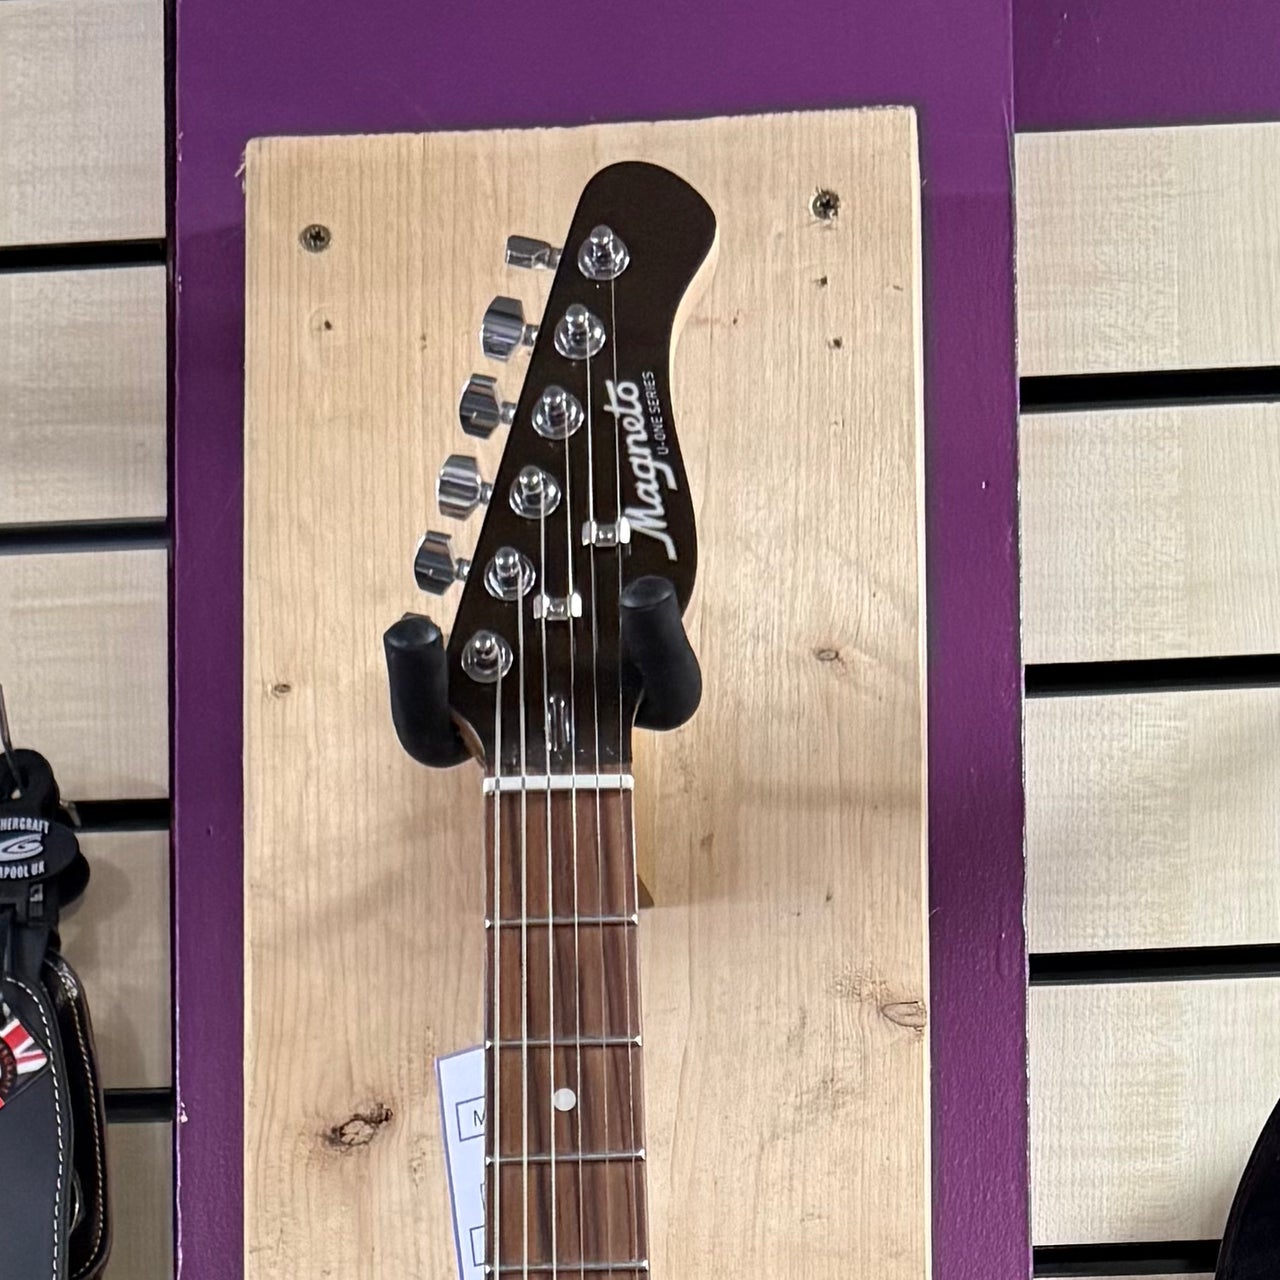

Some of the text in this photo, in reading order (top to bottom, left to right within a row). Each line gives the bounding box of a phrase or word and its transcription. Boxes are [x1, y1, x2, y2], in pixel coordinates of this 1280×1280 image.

[603, 379, 678, 561] Magneto
[642, 371, 669, 455] U-ONE SERIES
